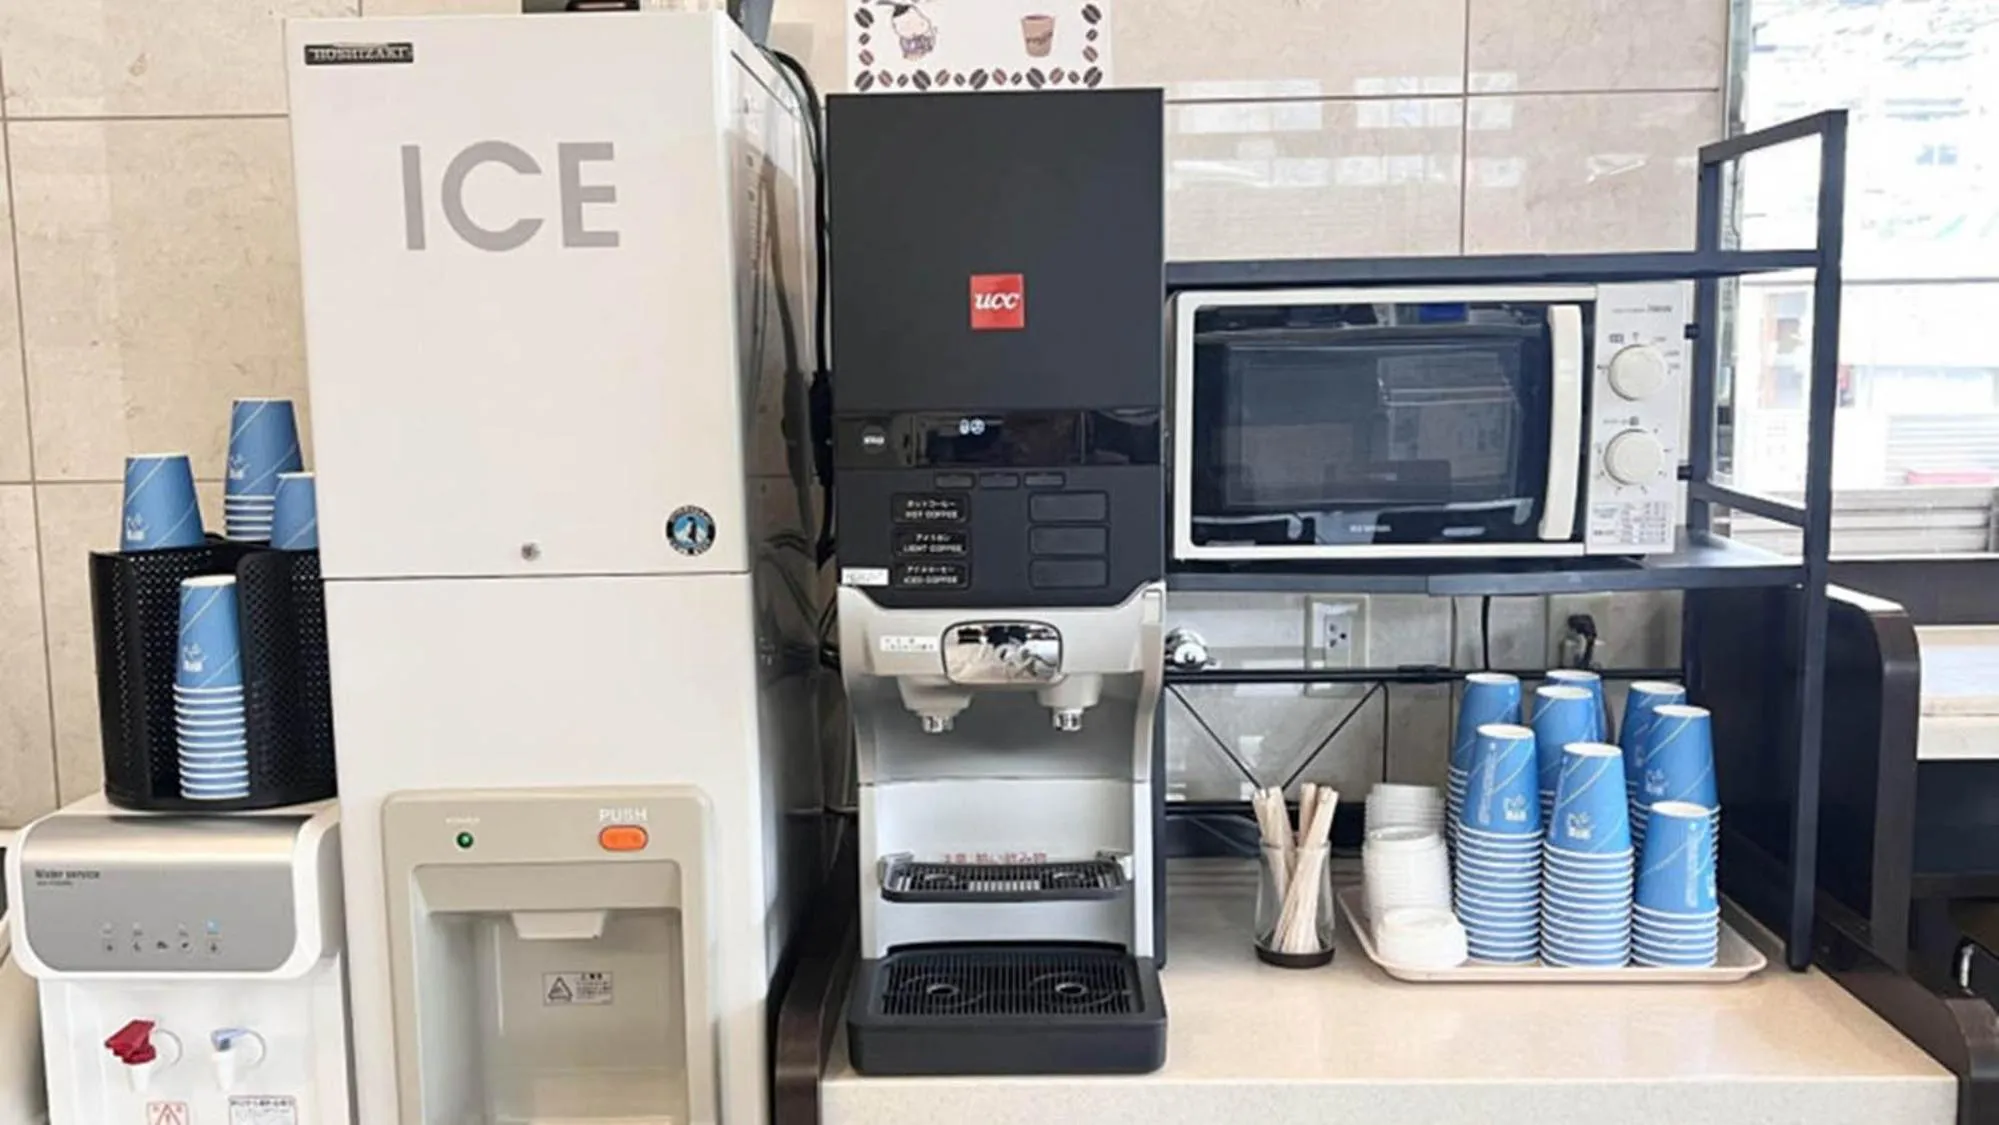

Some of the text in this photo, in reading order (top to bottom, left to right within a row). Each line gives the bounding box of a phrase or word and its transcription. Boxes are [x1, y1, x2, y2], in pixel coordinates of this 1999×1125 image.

[401, 140, 620, 252] ICE
[925, 509, 957, 519] COFFEE
[903, 543, 962, 553] LIGHT COFFEE
[925, 575, 957, 584] COFFEE
[599, 807, 648, 822] PUSH
